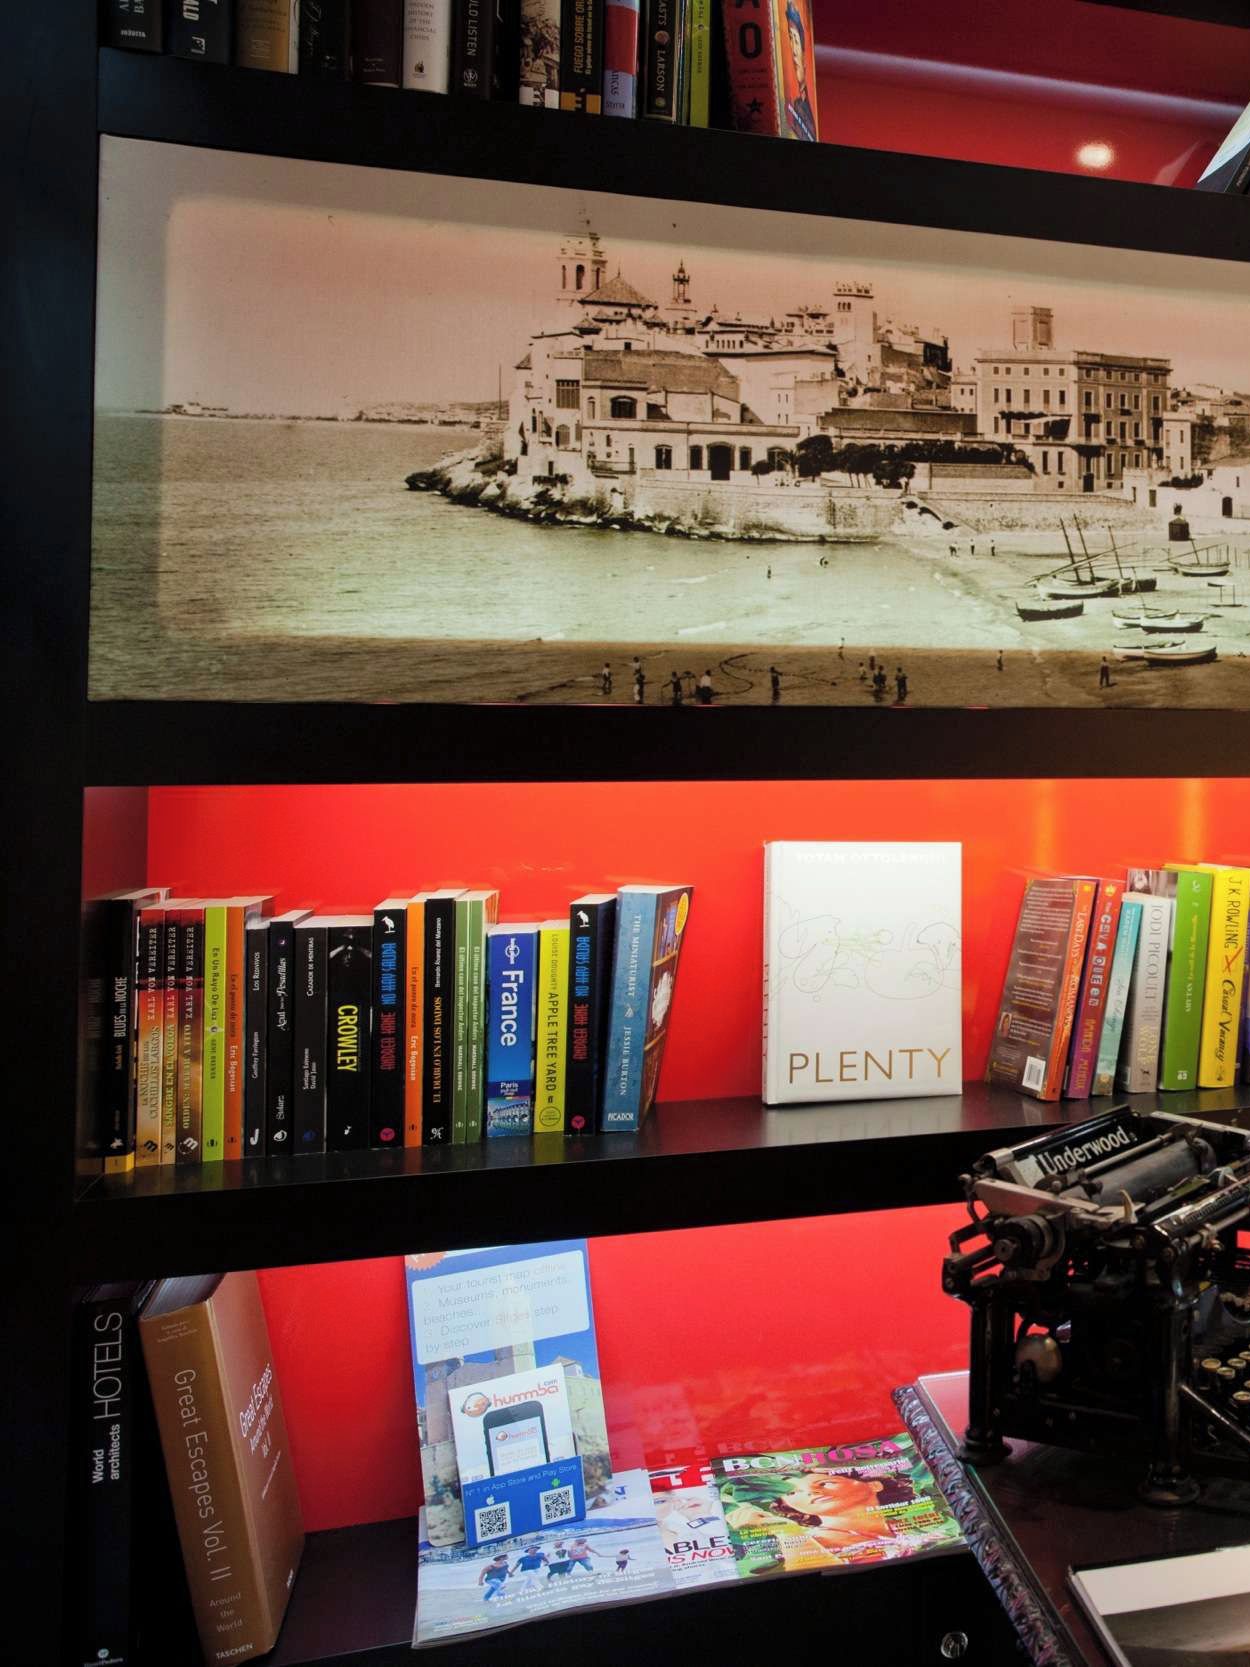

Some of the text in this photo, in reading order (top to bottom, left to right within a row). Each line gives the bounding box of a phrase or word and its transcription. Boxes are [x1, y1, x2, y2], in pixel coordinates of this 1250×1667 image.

[467, 19, 478, 56] LISTEN
[572, 15, 585, 74] FUEGO SOBRE
[656, 50, 667, 91] LARSON
[1228, 876, 1242, 895] J K
[1150, 903, 1164, 933] JODI
[380, 942, 397, 1005] NO HAY SALIDA
[575, 936, 591, 997] NO HAY SALIDA
[627, 915, 642, 997] THE MINIATURIST
[1148, 941, 1161, 1000] PICOULT
[117, 976, 128, 1004] NOCHE
[147, 976, 157, 994] VON
[167, 976, 176, 992] VON
[184, 976, 194, 992] VON
[210, 972, 220, 992] Rayo
[147, 996, 156, 1020] KARL
[167, 995, 176, 1019] KARL
[184, 995, 194, 1019] KARL
[501, 969, 525, 1047] France
[1214, 978, 1237, 1064] Casual Vacancy
[114, 1014, 127, 1038] BLUES
[337, 1004, 359, 1072] CROWLEY
[380, 1011, 397, 1071] ANDREA KANE
[410, 1035, 418, 1049] Eric
[545, 992, 559, 1092] APPLE TREE YARD
[573, 1003, 590, 1061] ANDREA KANE
[433, 996, 442, 1104] EL DIABLO EN LOS DADOS
[618, 1026, 632, 1096] JESSIE BURTON
[788, 1048, 952, 1084] PLENTY
[166, 1072, 174, 1086] EN
[164, 1087, 175, 1127] SANGRE
[607, 1112, 634, 1121] PICADOR
[1037, 1125, 1131, 1176] Underwood
[92, 1311, 124, 1421] HOTELS
[173, 1367, 202, 1425] Great
[493, 1384, 560, 1408] hummba
[239, 1398, 256, 1440] Great
[92, 1447, 105, 1484] World
[108, 1422, 121, 1481] architects
[185, 1430, 215, 1520] Escapes
[202, 1519, 229, 1563] Vol.
[209, 1566, 233, 1583] II
[209, 1592, 242, 1608] Around
[219, 1606, 236, 1619] the
[216, 1617, 244, 1633] World
[215, 1642, 254, 1662] TASCHEN
